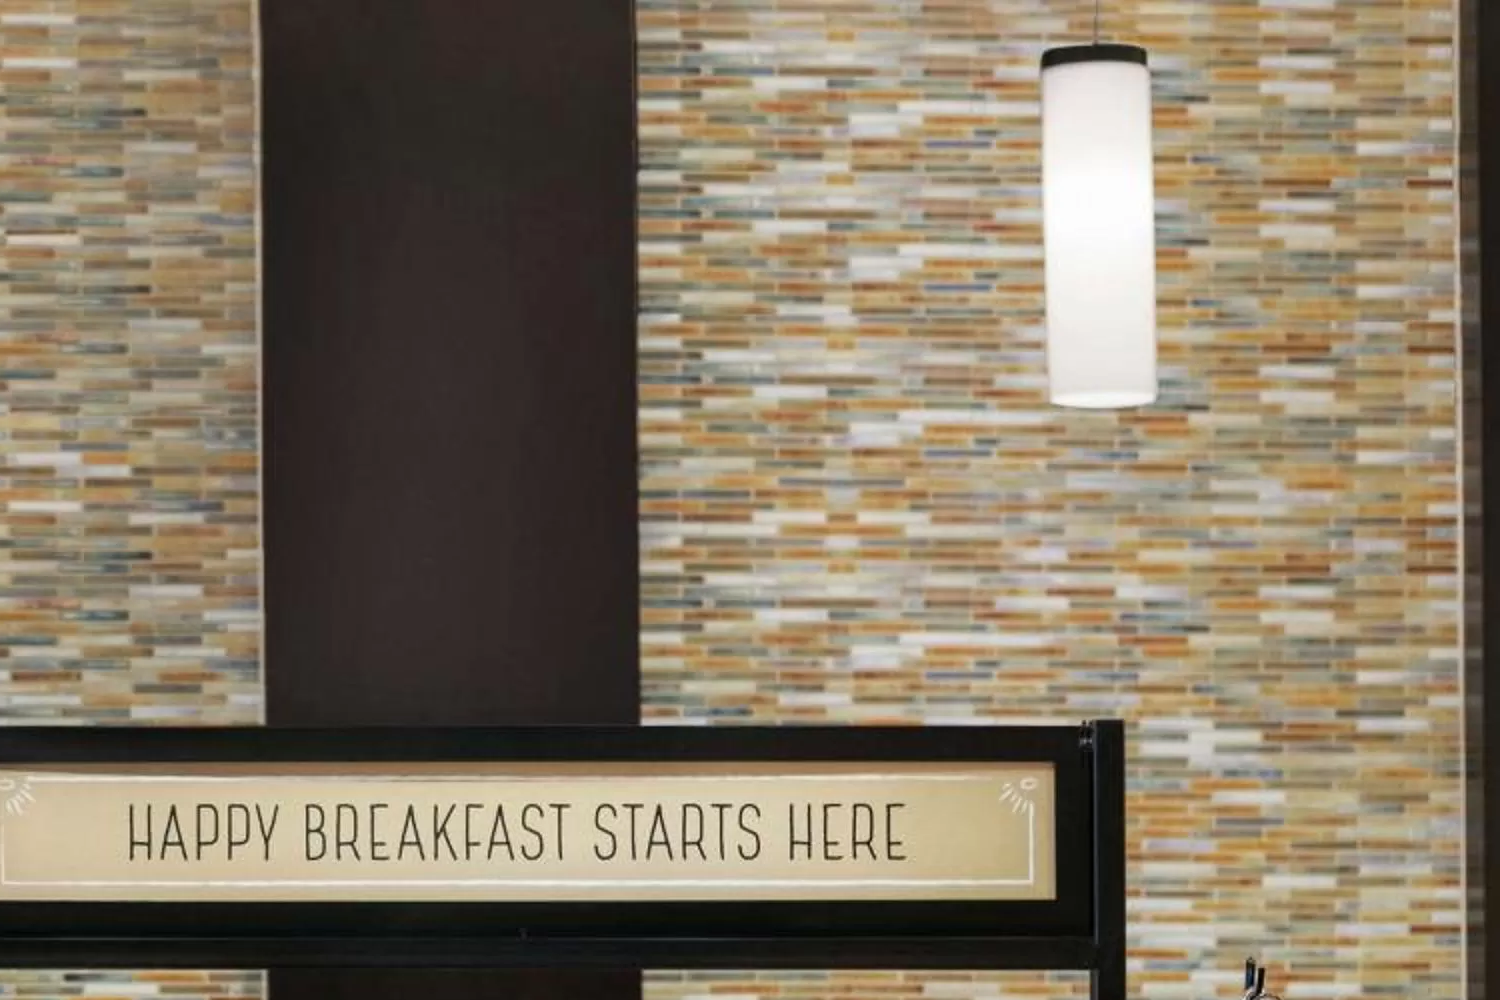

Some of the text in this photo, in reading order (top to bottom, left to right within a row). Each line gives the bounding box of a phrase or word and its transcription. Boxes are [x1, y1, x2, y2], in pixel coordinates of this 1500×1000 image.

[129, 802, 907, 861] HAPPY BREAKFAST STARTS HERE
